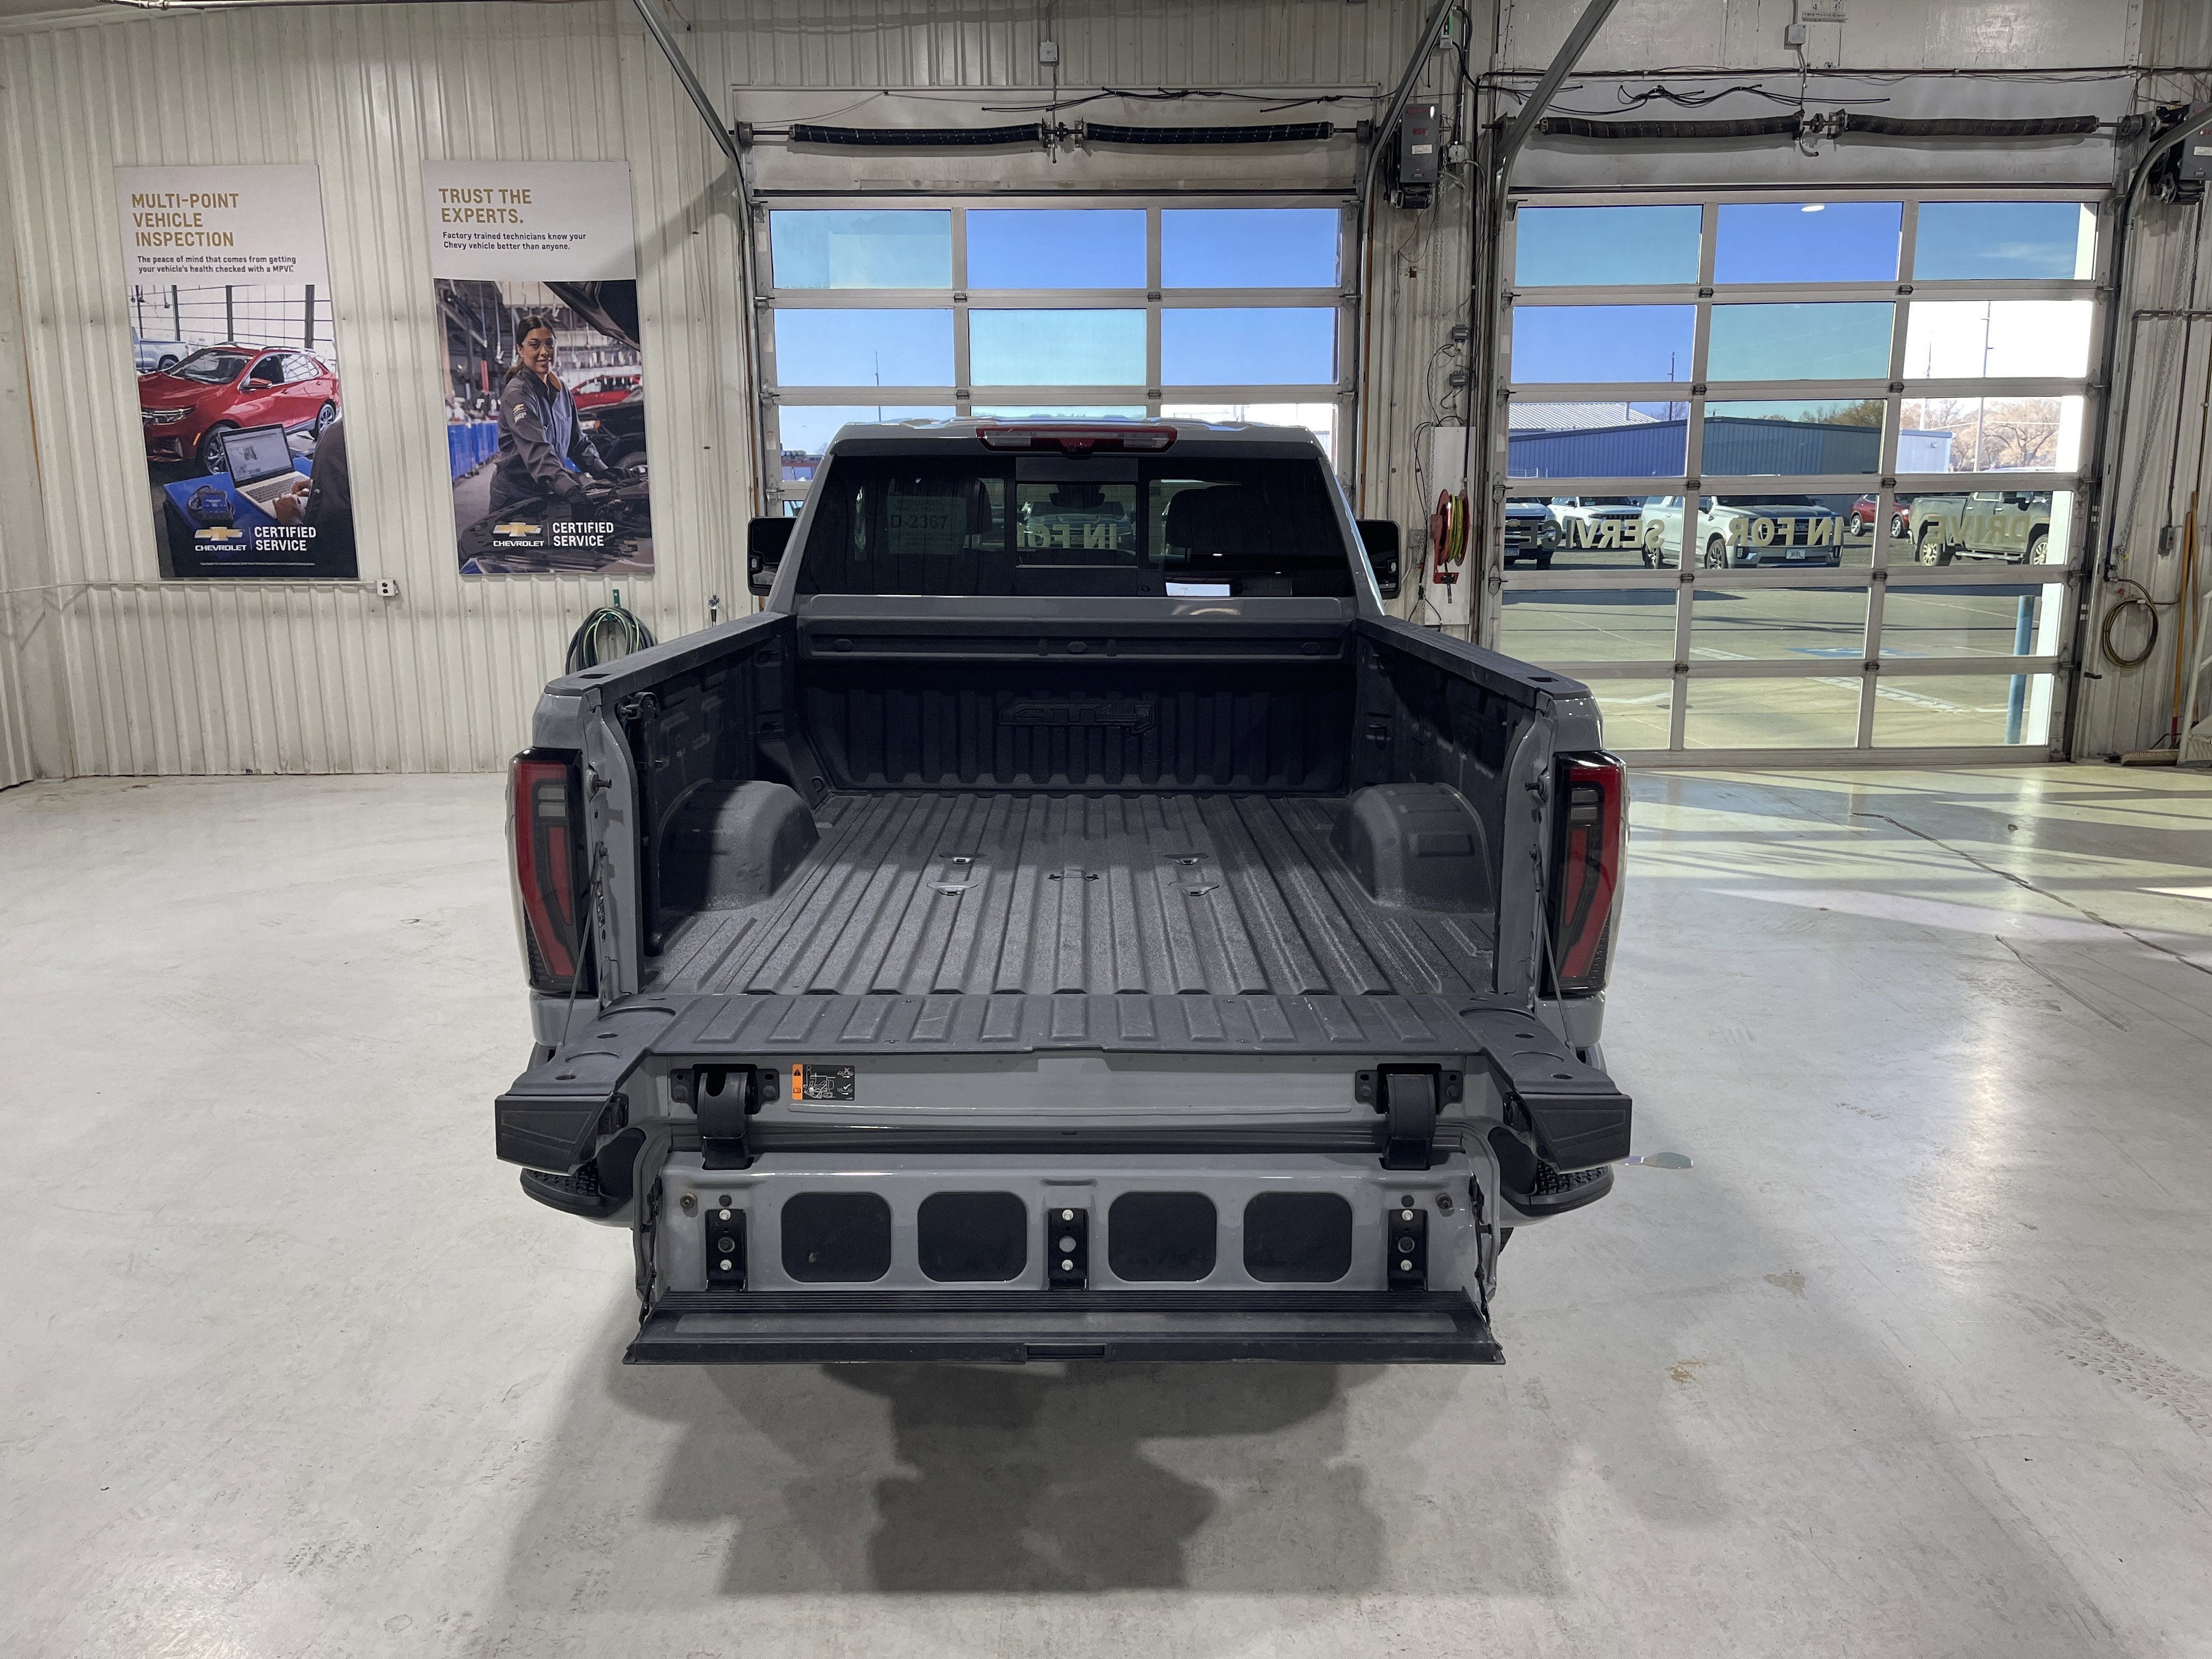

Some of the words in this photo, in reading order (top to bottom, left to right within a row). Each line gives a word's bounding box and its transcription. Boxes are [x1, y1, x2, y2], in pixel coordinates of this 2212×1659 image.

[132, 193, 239, 208] MULTI-POINT
[438, 188, 493, 204] TRUST
[498, 189, 532, 204] THE
[132, 212, 203, 228] VEHICLE
[441, 208, 524, 224] EXPERTS.
[136, 232, 234, 247] INSPECTION
[443, 232, 472, 240] Factory
[503, 232, 546, 240] technicians
[444, 241, 467, 250] Chevy
[469, 241, 495, 250] vehicle
[269, 255, 296, 264] getting
[138, 266, 155, 274] your
[156, 264, 188, 273] vehicle's
[189, 264, 213, 273] health
[890, 514, 949, 529] D-2367
[253, 526, 317, 538] CERTIFIED
[552, 522, 614, 534] CERTIFIED
[255, 539, 307, 551] SERVICE
[553, 534, 605, 546] SERVICE
[1000, 701, 1155, 733] AT4
